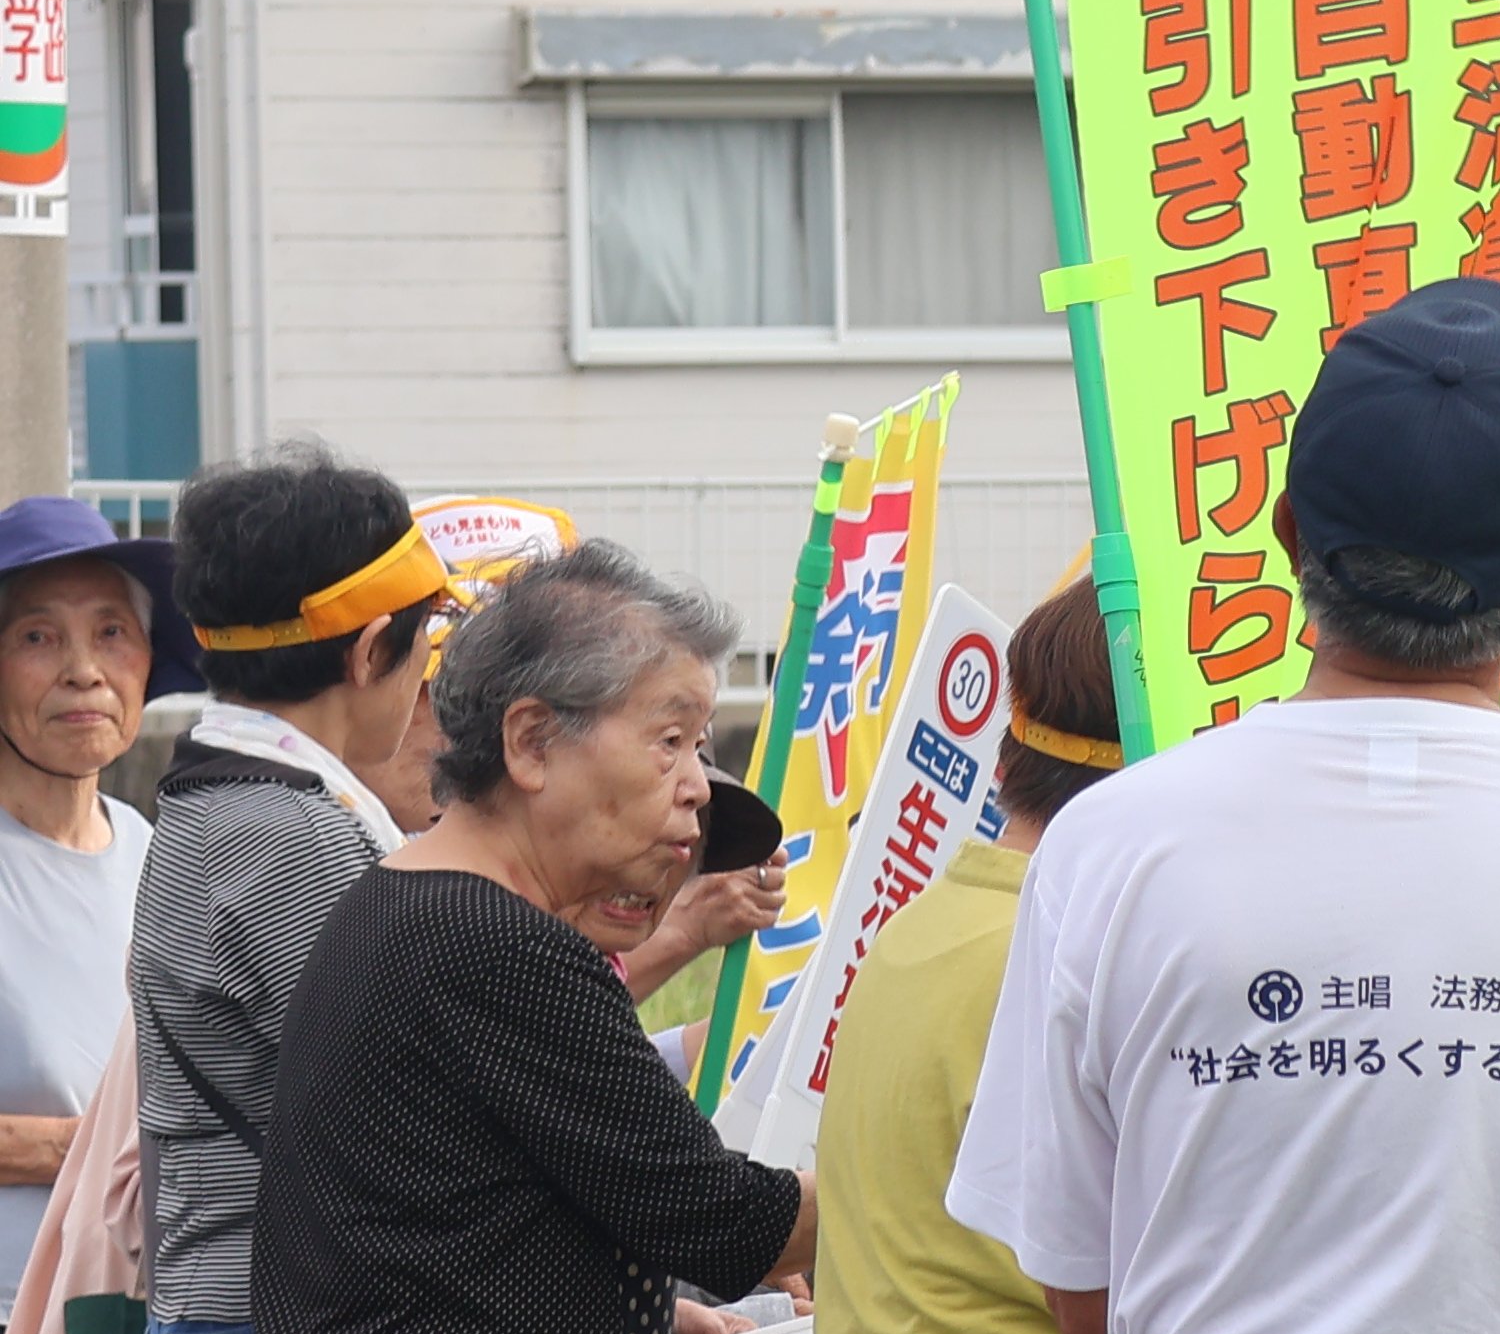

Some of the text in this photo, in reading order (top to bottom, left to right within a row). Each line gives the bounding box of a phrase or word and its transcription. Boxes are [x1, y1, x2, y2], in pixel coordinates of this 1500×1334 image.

[952, 659, 985, 711] 30
[914, 730, 970, 793] ここは
[1320, 975, 1392, 1012] 主唱
